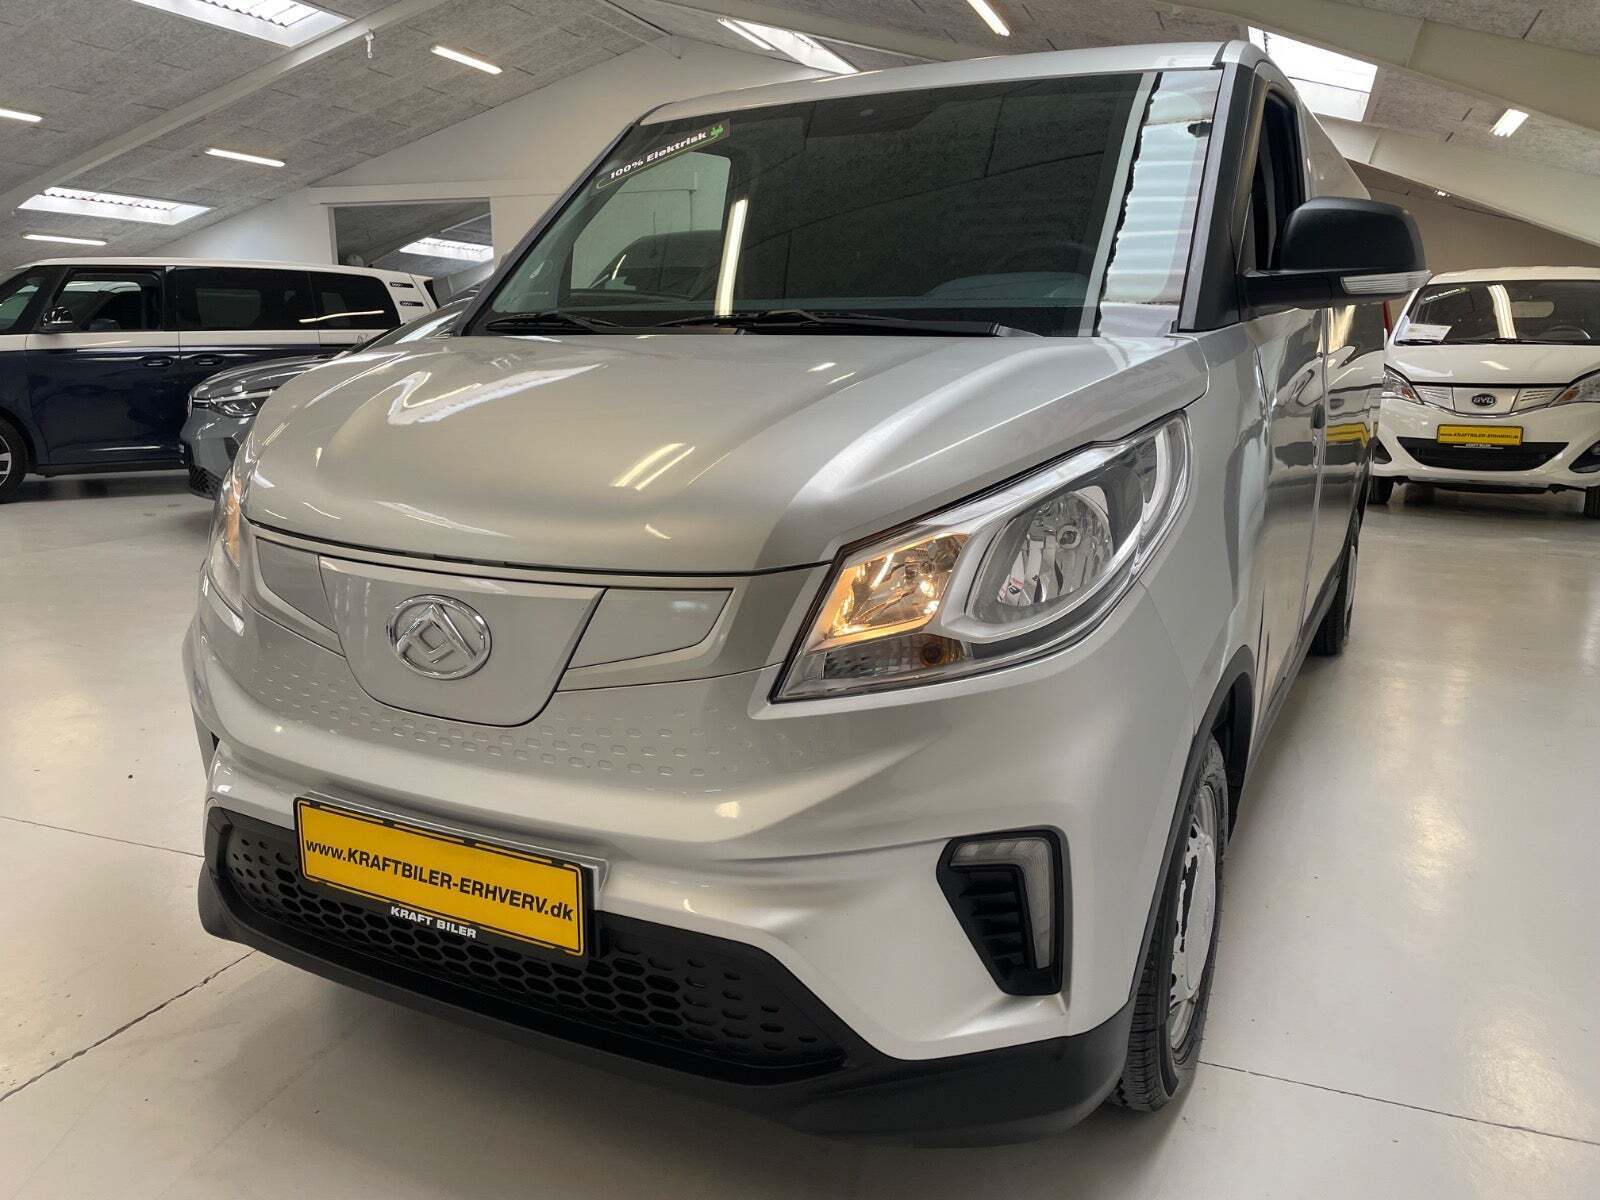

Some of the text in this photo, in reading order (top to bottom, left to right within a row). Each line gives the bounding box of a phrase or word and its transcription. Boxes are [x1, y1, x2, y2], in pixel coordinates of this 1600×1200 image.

[610, 132, 707, 179] 100% Elektrisk
[1473, 395, 1495, 405] BYD
[305, 839, 574, 922] www.KRAFTBILER-ERHVERV.dk
[390, 905, 477, 939] KRAFT BILER
